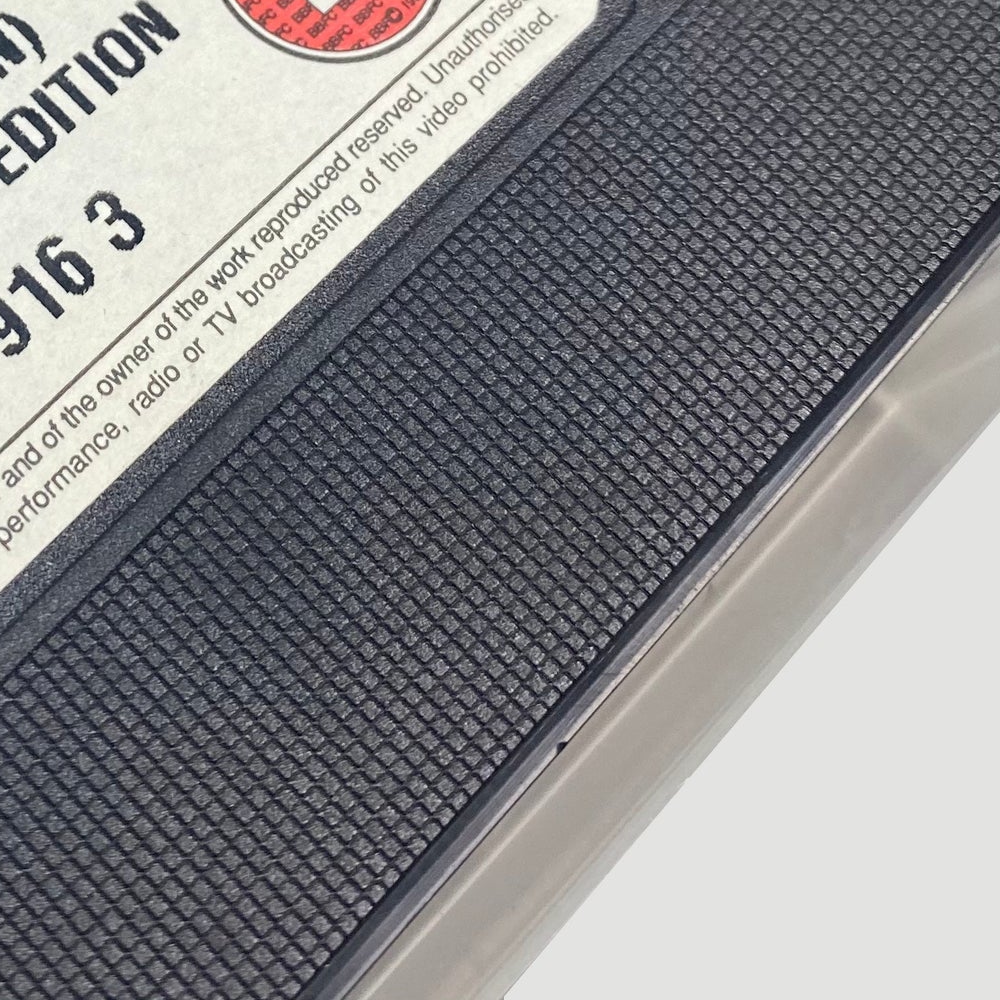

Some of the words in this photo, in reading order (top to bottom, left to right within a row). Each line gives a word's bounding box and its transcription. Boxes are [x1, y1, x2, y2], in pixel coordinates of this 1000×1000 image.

[2, 442, 43, 488] and
[42, 420, 64, 449] of
[60, 395, 97, 428] the
[97, 336, 155, 396] owner
[155, 312, 177, 340] of
[172, 289, 208, 321] the
[205, 246, 255, 290] work
[250, 151, 351, 250] reproduced
[347, 84, 428, 159] reserved.
[83, 190, 146, 251] 3
[128, 365, 180, 416] radio
[183, 337, 205, 363] or
[202, 301, 237, 336] TV
[236, 195, 361, 307] broadcasting
[360, 167, 381, 193] of
[379, 139, 418, 172] this
[417, 92, 467, 136] video
[468, 7, 559, 95] prohibited.
